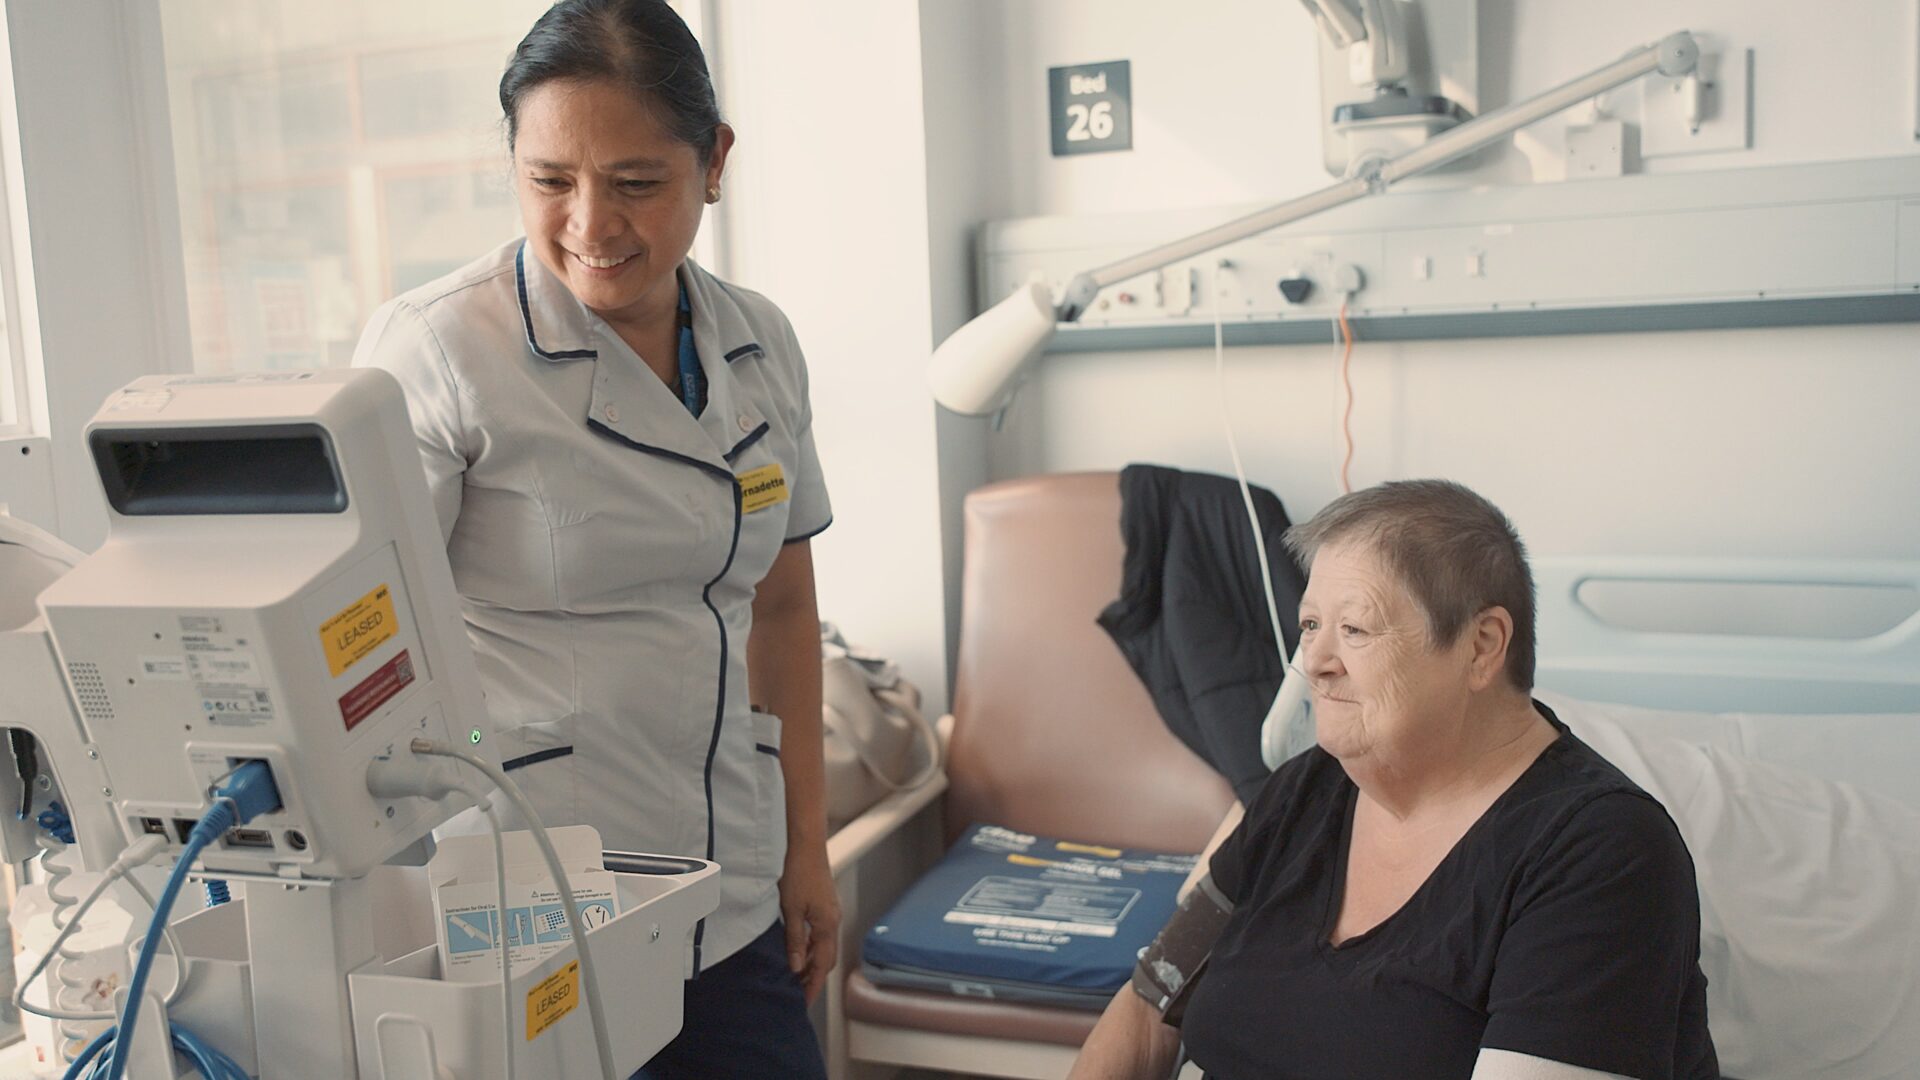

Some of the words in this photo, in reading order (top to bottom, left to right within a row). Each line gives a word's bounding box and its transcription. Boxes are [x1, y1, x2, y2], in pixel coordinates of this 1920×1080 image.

[1070, 71, 1106, 95] Bed
[1066, 101, 1113, 141] 26
[337, 610, 383, 651] LEASED
[536, 983, 571, 1016] LEASED
